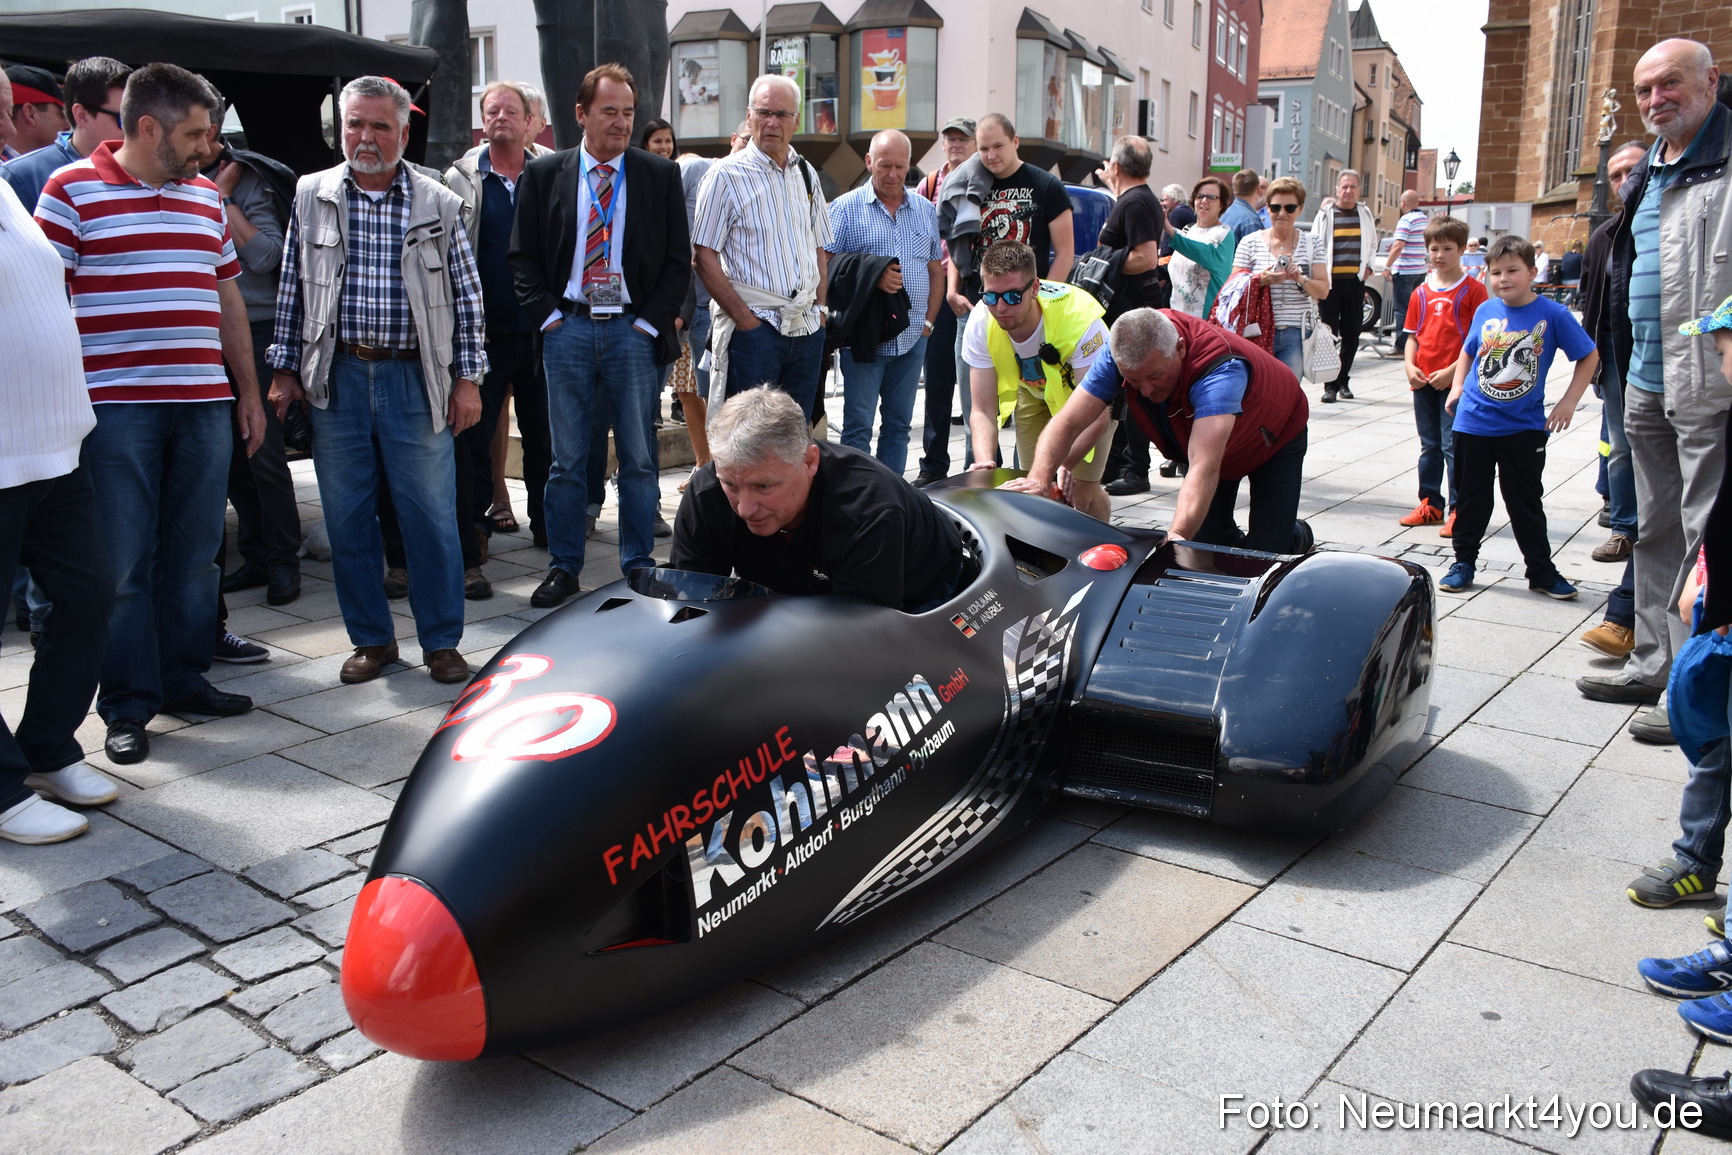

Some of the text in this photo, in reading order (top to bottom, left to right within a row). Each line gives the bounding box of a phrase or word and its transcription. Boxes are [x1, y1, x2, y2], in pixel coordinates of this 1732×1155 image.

[770, 48, 799, 66] RACKL
[1287, 99, 1302, 177] satzk
[1007, 187, 1034, 200] PARK
[1081, 331, 1104, 359] 29
[1509, 387, 1525, 398] BAY
[966, 588, 998, 616] KOHLMANN
[969, 600, 1005, 631] W. ANDERLE
[432, 653, 618, 763] 30
[685, 667, 970, 909] Kohlmann GmbH
[602, 725, 797, 886] FAHRSCHULE
[697, 719, 956, 938] Neumarkt Altdorf Burgthann Pyrbaum
